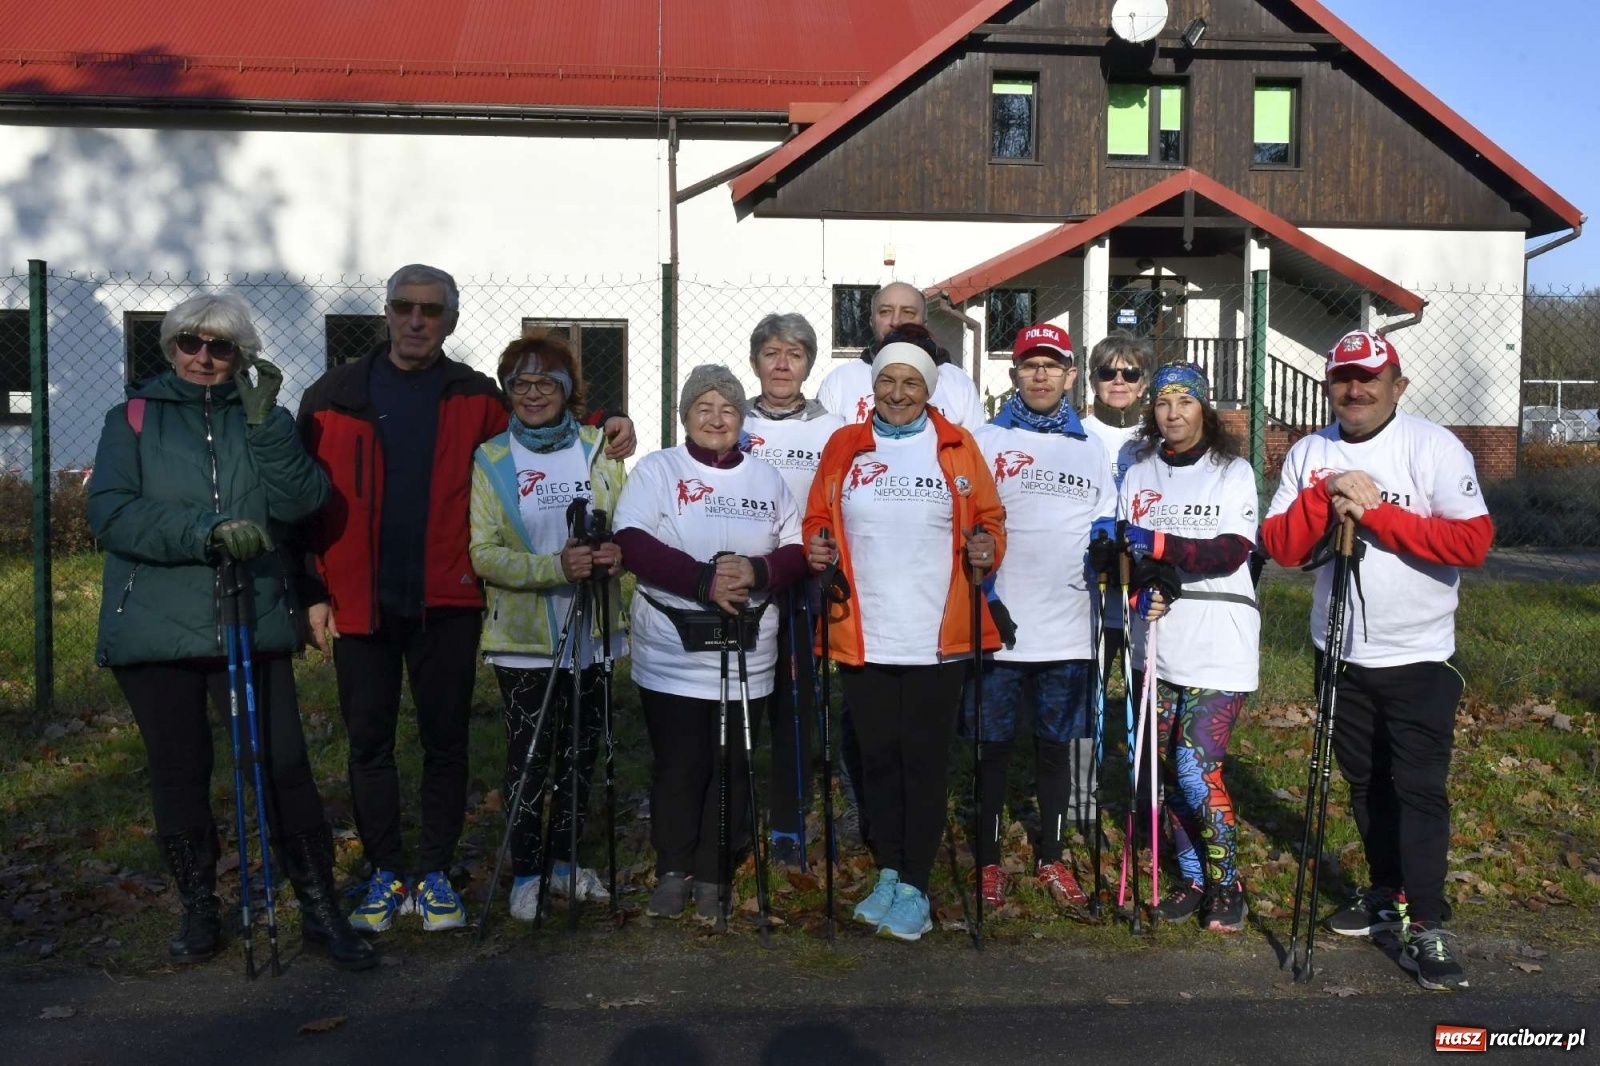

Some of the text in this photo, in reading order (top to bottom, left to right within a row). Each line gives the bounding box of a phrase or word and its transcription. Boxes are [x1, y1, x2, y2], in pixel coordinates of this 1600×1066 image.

[1025, 328, 1060, 341] POLSKA
[752, 448, 821, 460] BIEG 2021
[1111, 462, 1128, 472] EG
[875, 476, 909, 487] BIEG
[915, 477, 949, 492] 2021
[1021, 468, 1091, 489] BIEG 2021
[535, 480, 592, 496] BIEG 20
[704, 494, 776, 511] BIEG 2021
[1380, 490, 1411, 507] 021
[1149, 504, 1220, 517] BIEG 2021
